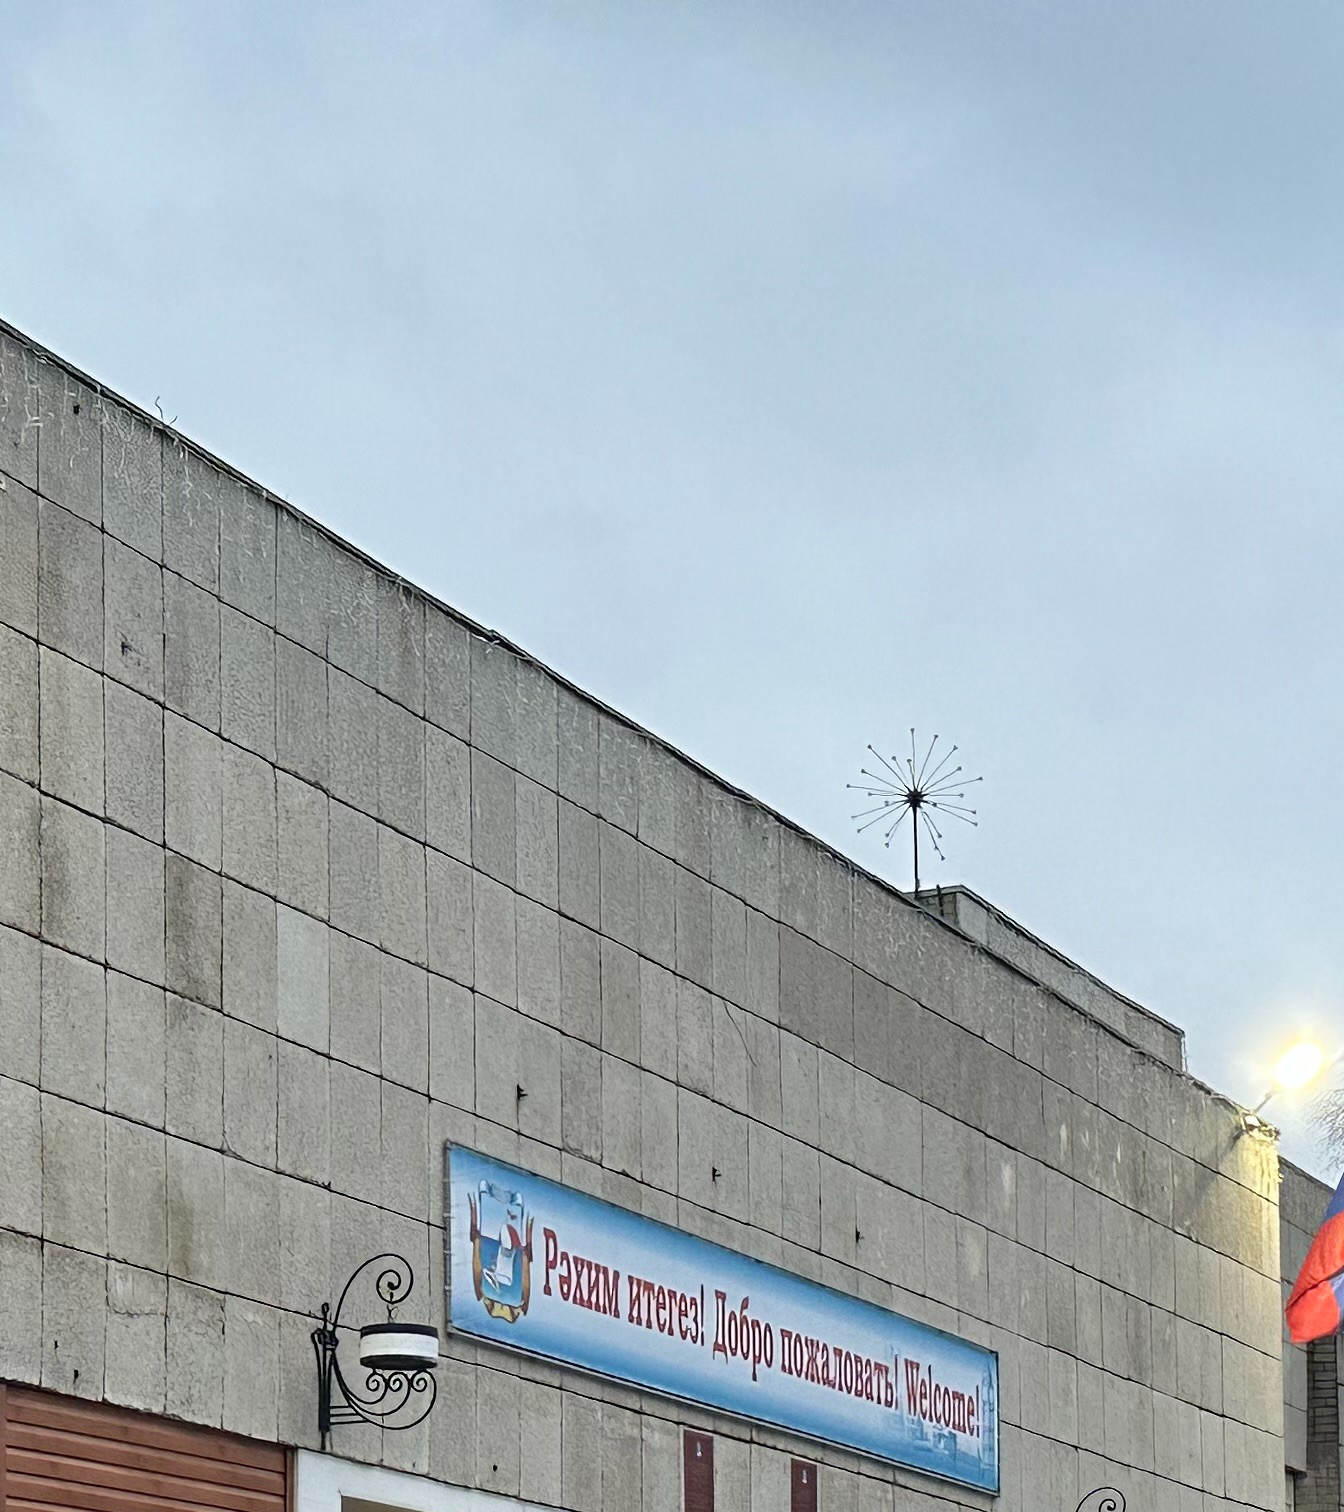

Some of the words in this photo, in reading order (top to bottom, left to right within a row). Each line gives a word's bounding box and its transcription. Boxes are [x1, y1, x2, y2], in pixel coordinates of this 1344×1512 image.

[543, 1227, 620, 1319] Рәхим
[627, 1275, 705, 1346] итегез!
[712, 1289, 774, 1382] Добро
[779, 1328, 899, 1410] пожаловать!
[904, 1357, 980, 1438] Welcome!
